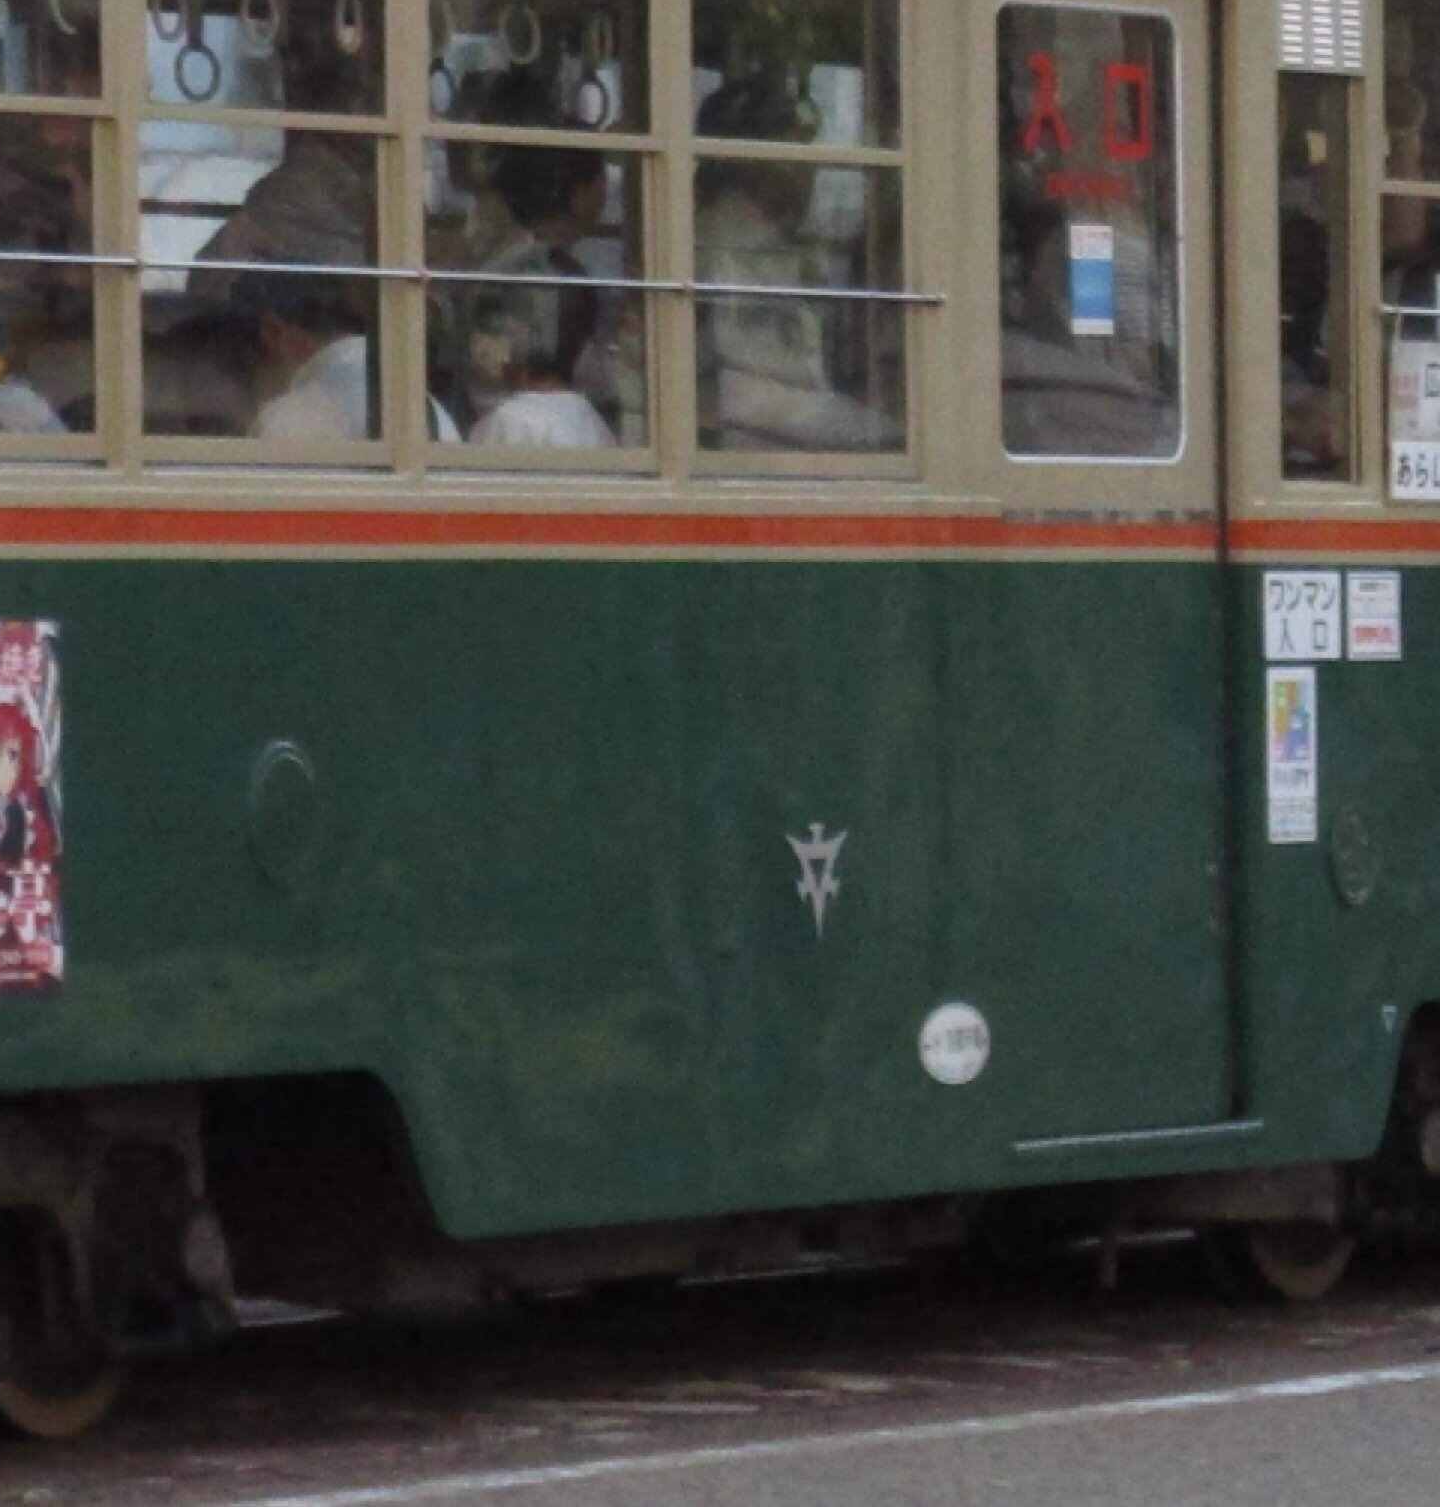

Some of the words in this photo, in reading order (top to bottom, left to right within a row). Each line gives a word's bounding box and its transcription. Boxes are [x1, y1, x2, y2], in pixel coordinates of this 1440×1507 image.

[1023, 52, 1153, 161] 入口
[1268, 579, 1337, 611] ワンマン
[1278, 617, 1329, 652] 入口
